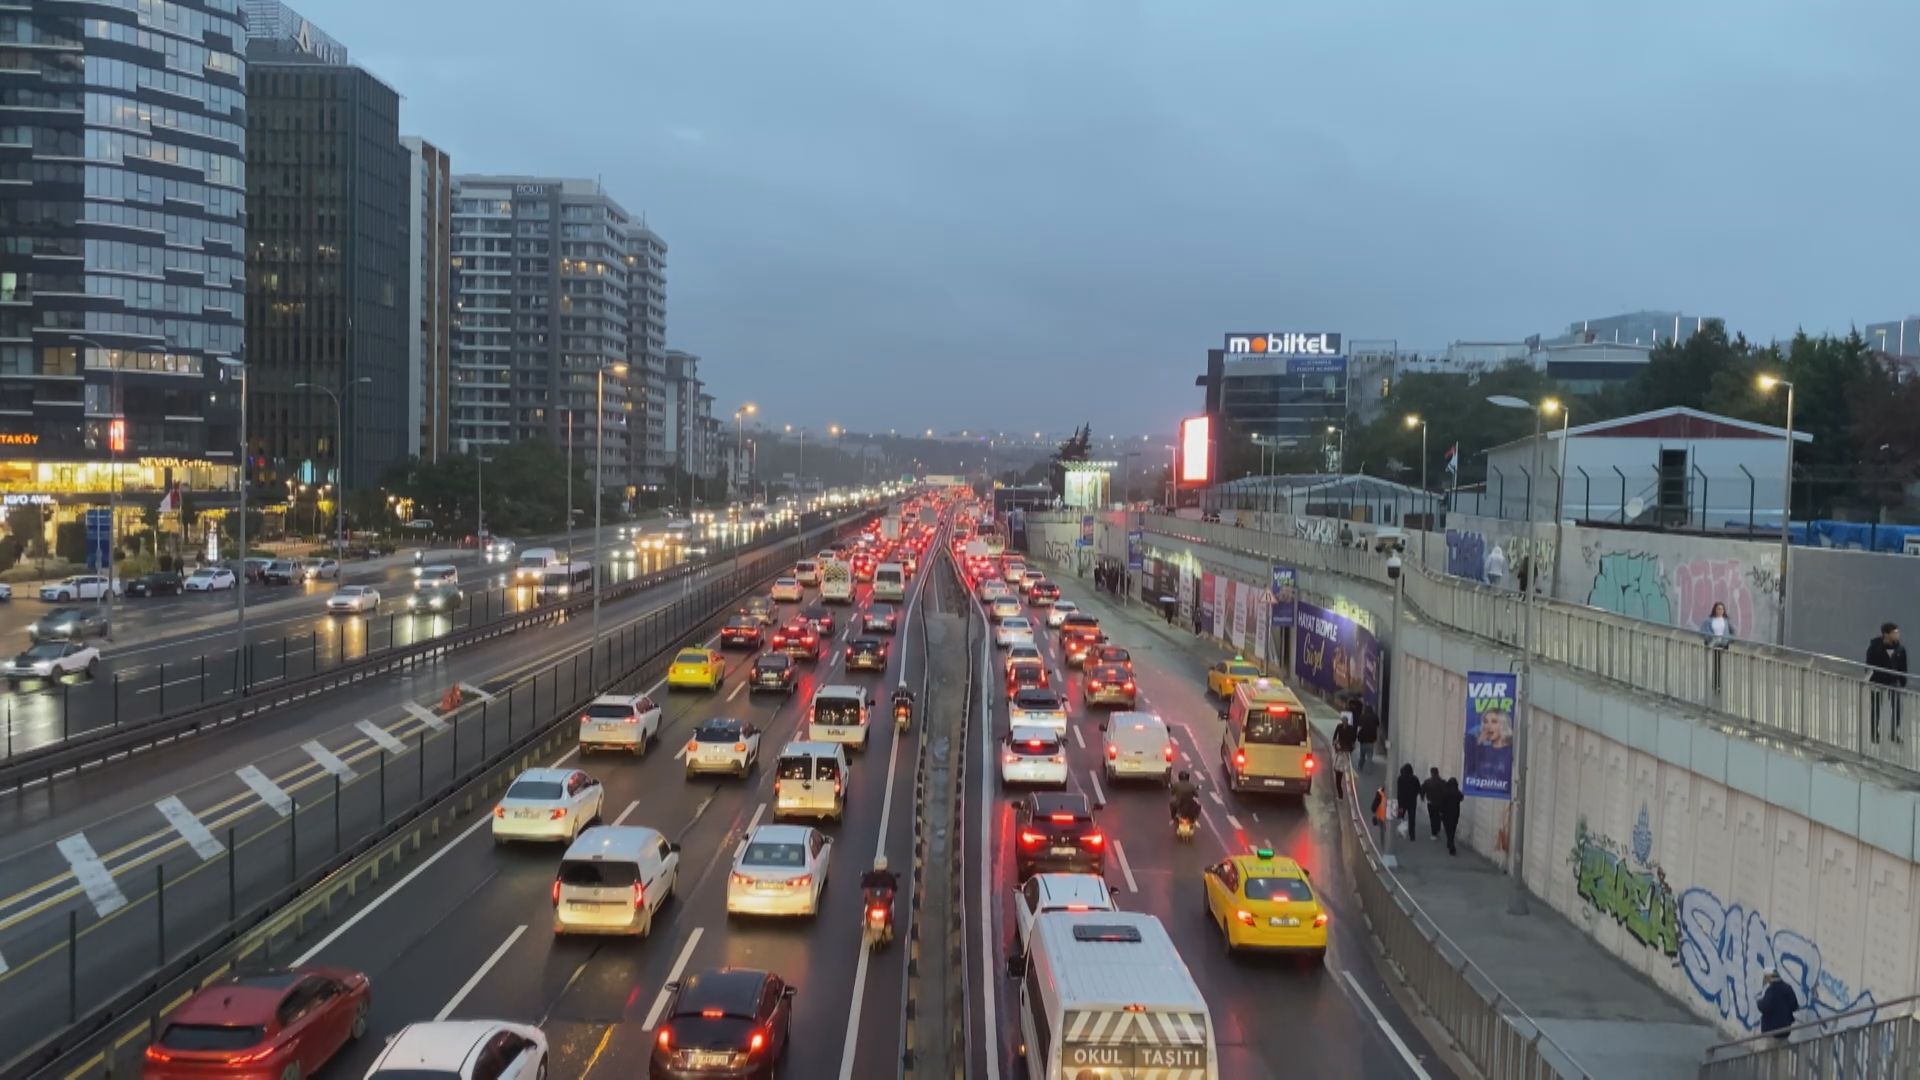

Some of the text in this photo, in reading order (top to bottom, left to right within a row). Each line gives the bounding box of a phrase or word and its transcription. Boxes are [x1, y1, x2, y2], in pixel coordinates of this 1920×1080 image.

[1468, 682, 1508, 698] VAR
[1475, 698, 1514, 713] VAR
[1074, 1048, 1199, 1067] OKUL TAŞITI
